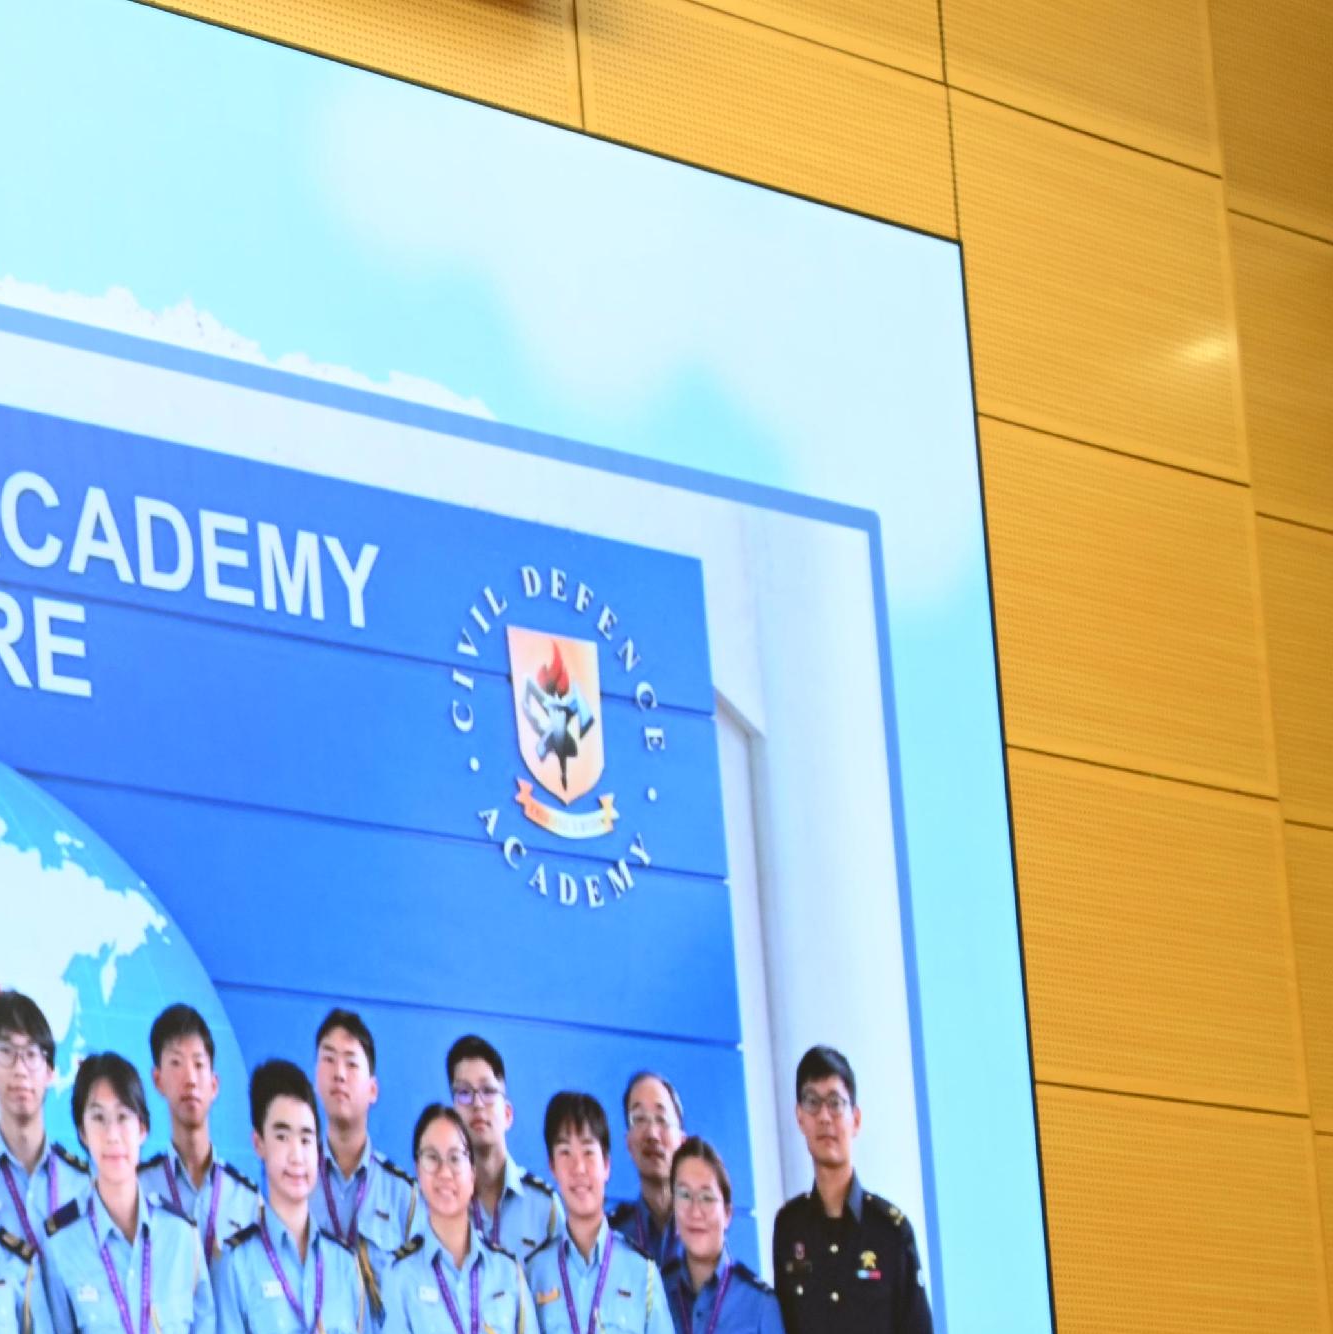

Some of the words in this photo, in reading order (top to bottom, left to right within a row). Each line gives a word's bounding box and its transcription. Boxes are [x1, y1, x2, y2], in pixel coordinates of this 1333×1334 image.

[452, 586, 509, 732] CIVIL
[521, 565, 665, 751] DEFENCE
[478, 807, 652, 908] ACADEMY
